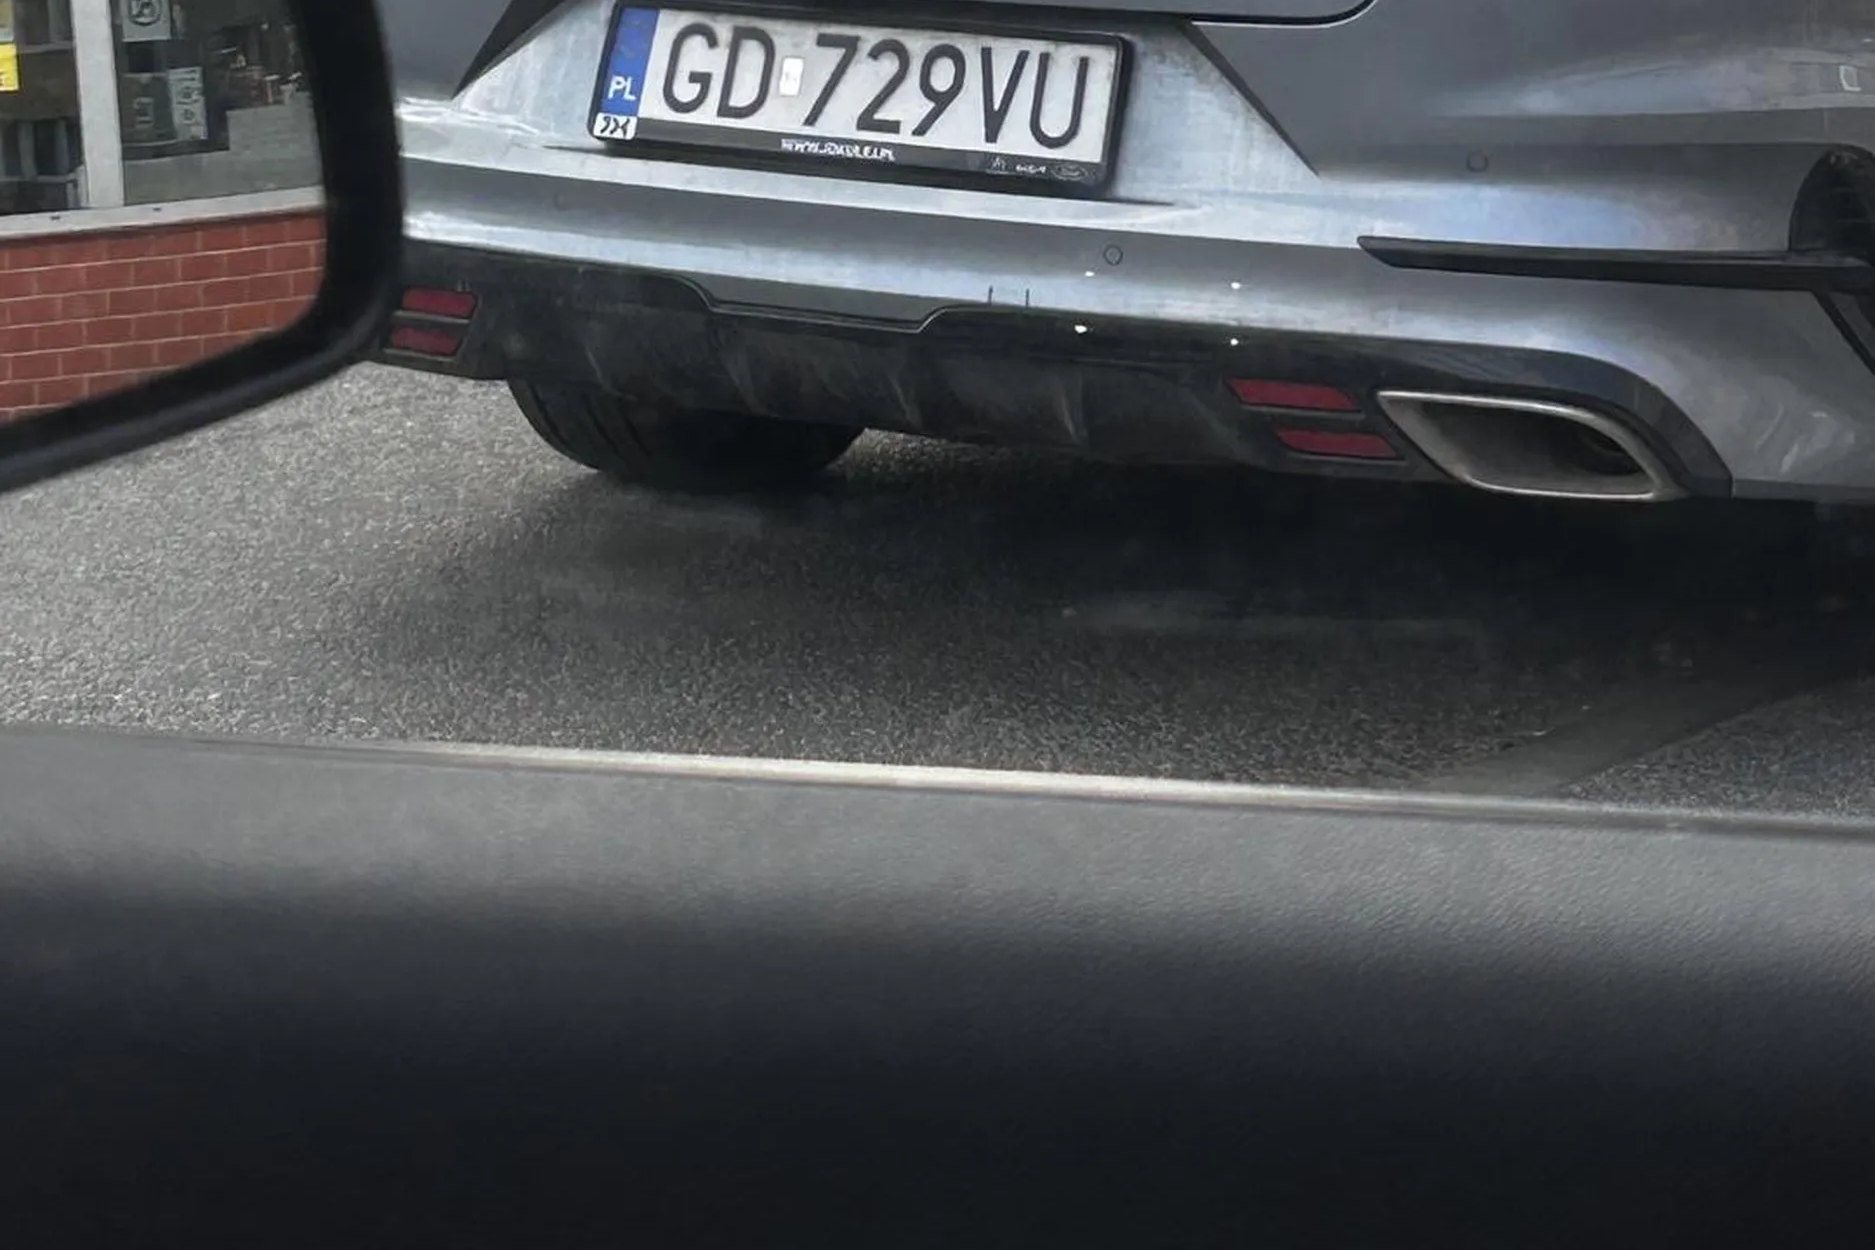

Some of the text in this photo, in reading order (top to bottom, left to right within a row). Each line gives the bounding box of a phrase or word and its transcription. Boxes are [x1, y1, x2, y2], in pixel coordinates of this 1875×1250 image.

[607, 75, 637, 100] PL
[662, 22, 1089, 149] GD 729VU
